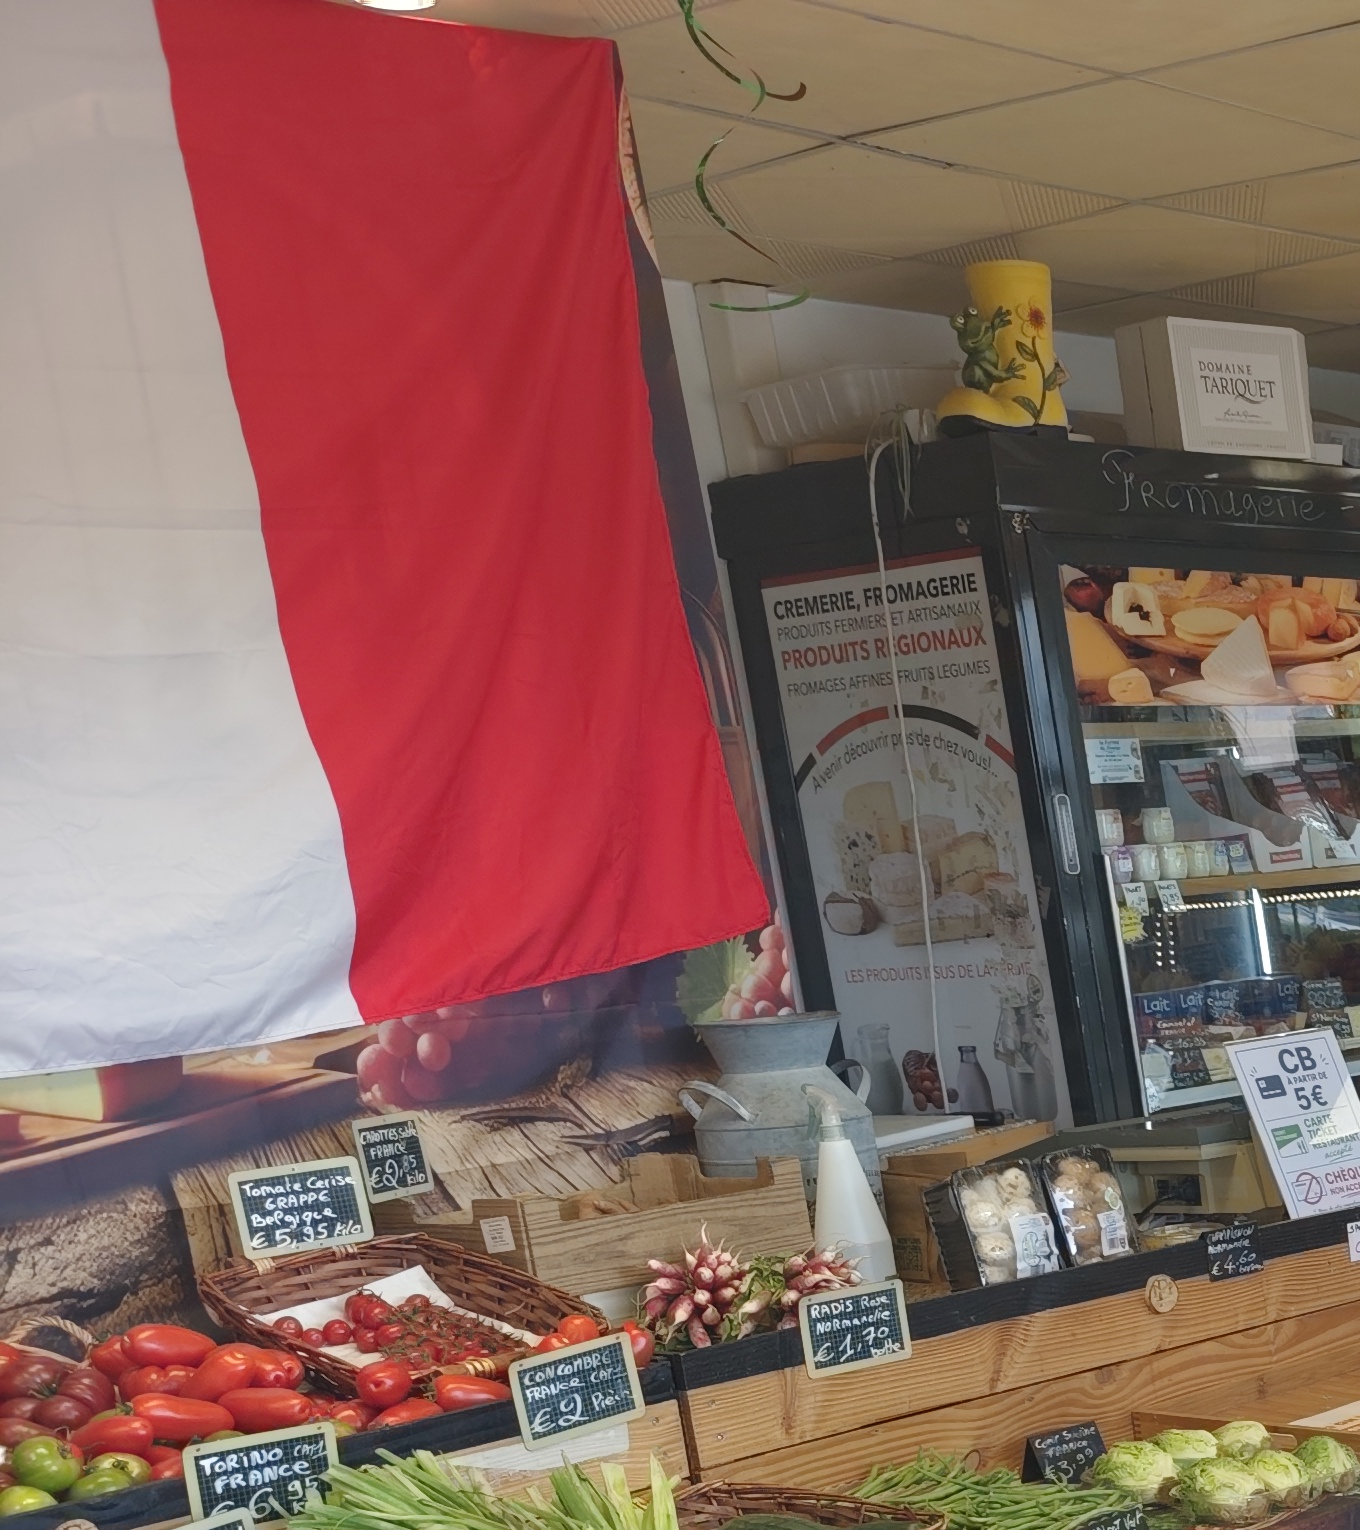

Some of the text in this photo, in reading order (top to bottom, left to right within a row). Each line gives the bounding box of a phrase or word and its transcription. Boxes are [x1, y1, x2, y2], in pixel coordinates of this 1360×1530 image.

[1198, 361, 1252, 376] DOMAINE
[1200, 375, 1276, 404] TARIQUET
[773, 572, 978, 621] CREMERIE, FROMAGERIE
[777, 600, 983, 642] PRODUITS FERMIERS ET ARTISANAUX
[781, 640, 871, 671] PRODUITS
[787, 660, 991, 697] FROMAGES AFFINES FRUITS LEGUMES
[844, 726, 959, 764] découvrir de chez
[845, 968, 864, 984] LES
[866, 966, 922, 982] PRODUITS
[957, 964, 975, 979] DE
[1143, 998, 1170, 1013] Lait
[1278, 1046, 1317, 1074] CB
[1287, 1071, 1328, 1085] À PARTIR DE
[1294, 1084, 1328, 1110] 5€
[1304, 1114, 1331, 1128] CARTE
[1307, 1125, 1338, 1140] TICKET
[241, 1175, 357, 1197] Tomate Cerise
[1330, 1186, 1345, 1195] NON
[251, 1208, 338, 1229] Belgique
[275, 1225, 328, 1249] 5,95
[840, 1326, 889, 1362] 1,70
